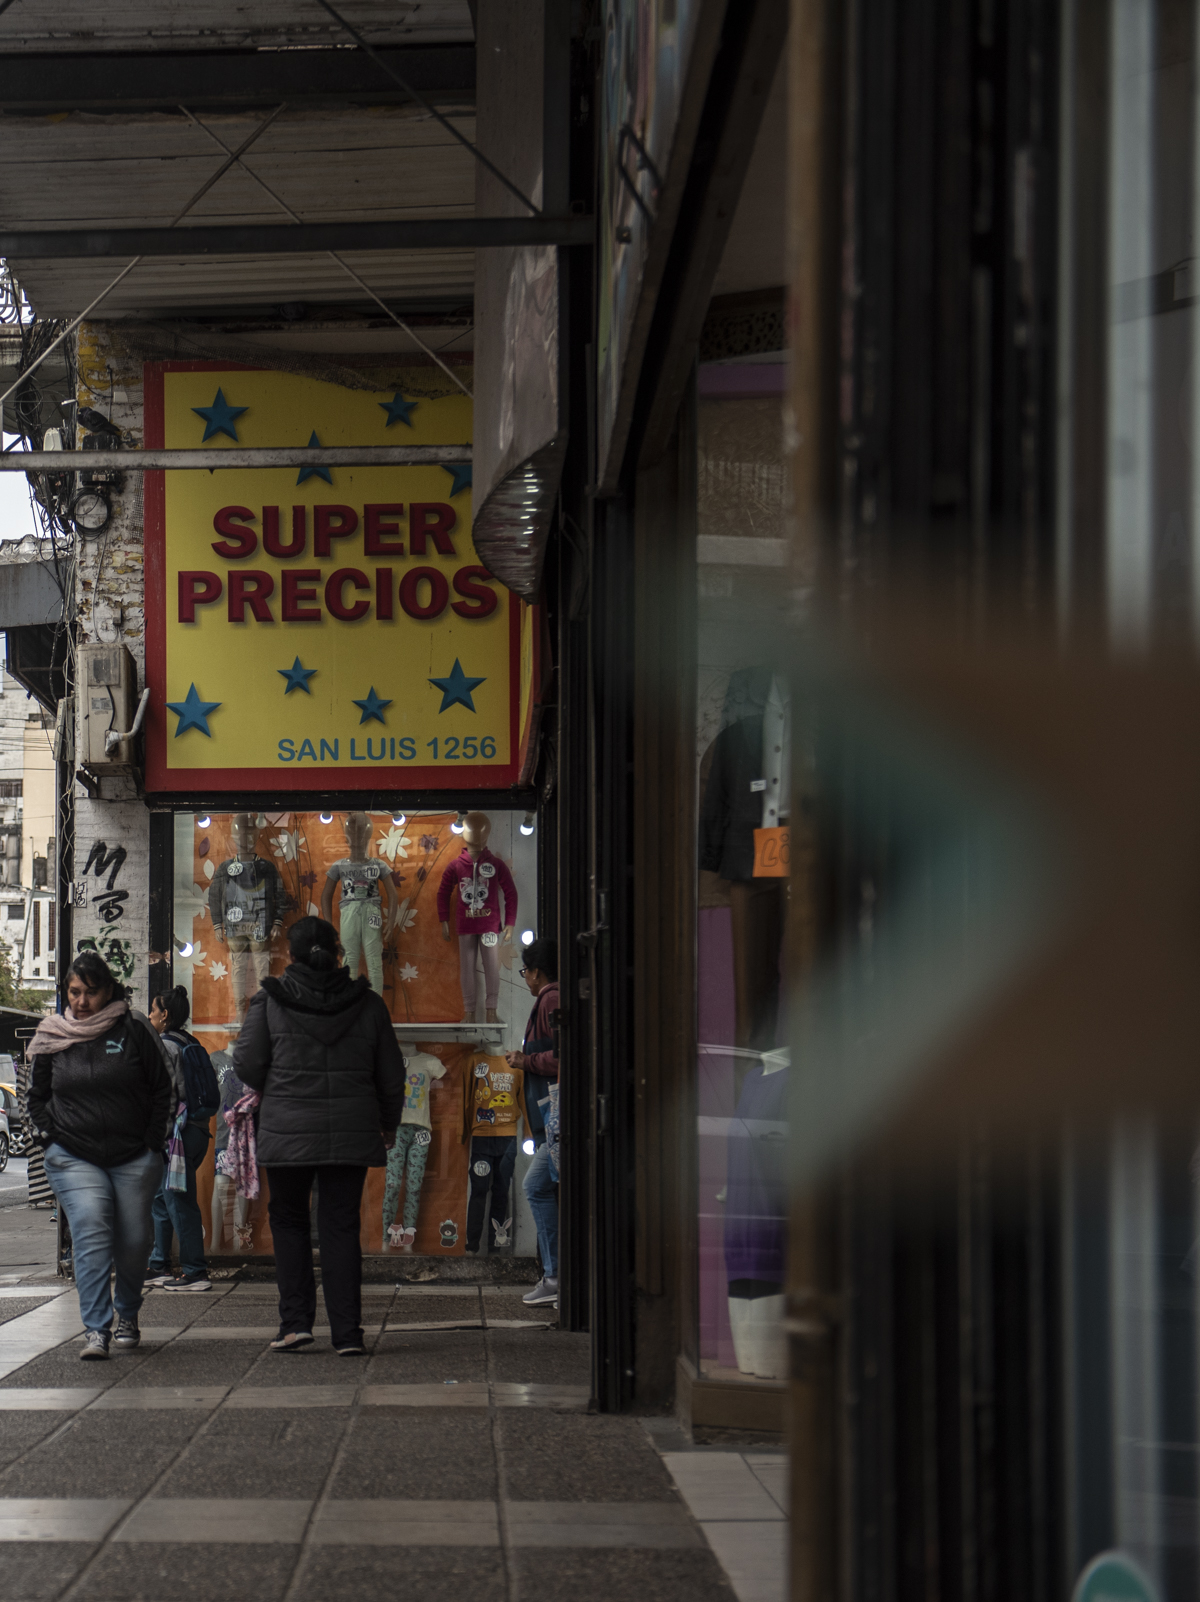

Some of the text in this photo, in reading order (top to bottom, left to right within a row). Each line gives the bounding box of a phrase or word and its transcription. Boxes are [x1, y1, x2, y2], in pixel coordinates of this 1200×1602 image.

[211, 502, 457, 559] SUPER
[178, 565, 498, 623] PRECIOS
[277, 736, 497, 762] SAN LUIS 1256
